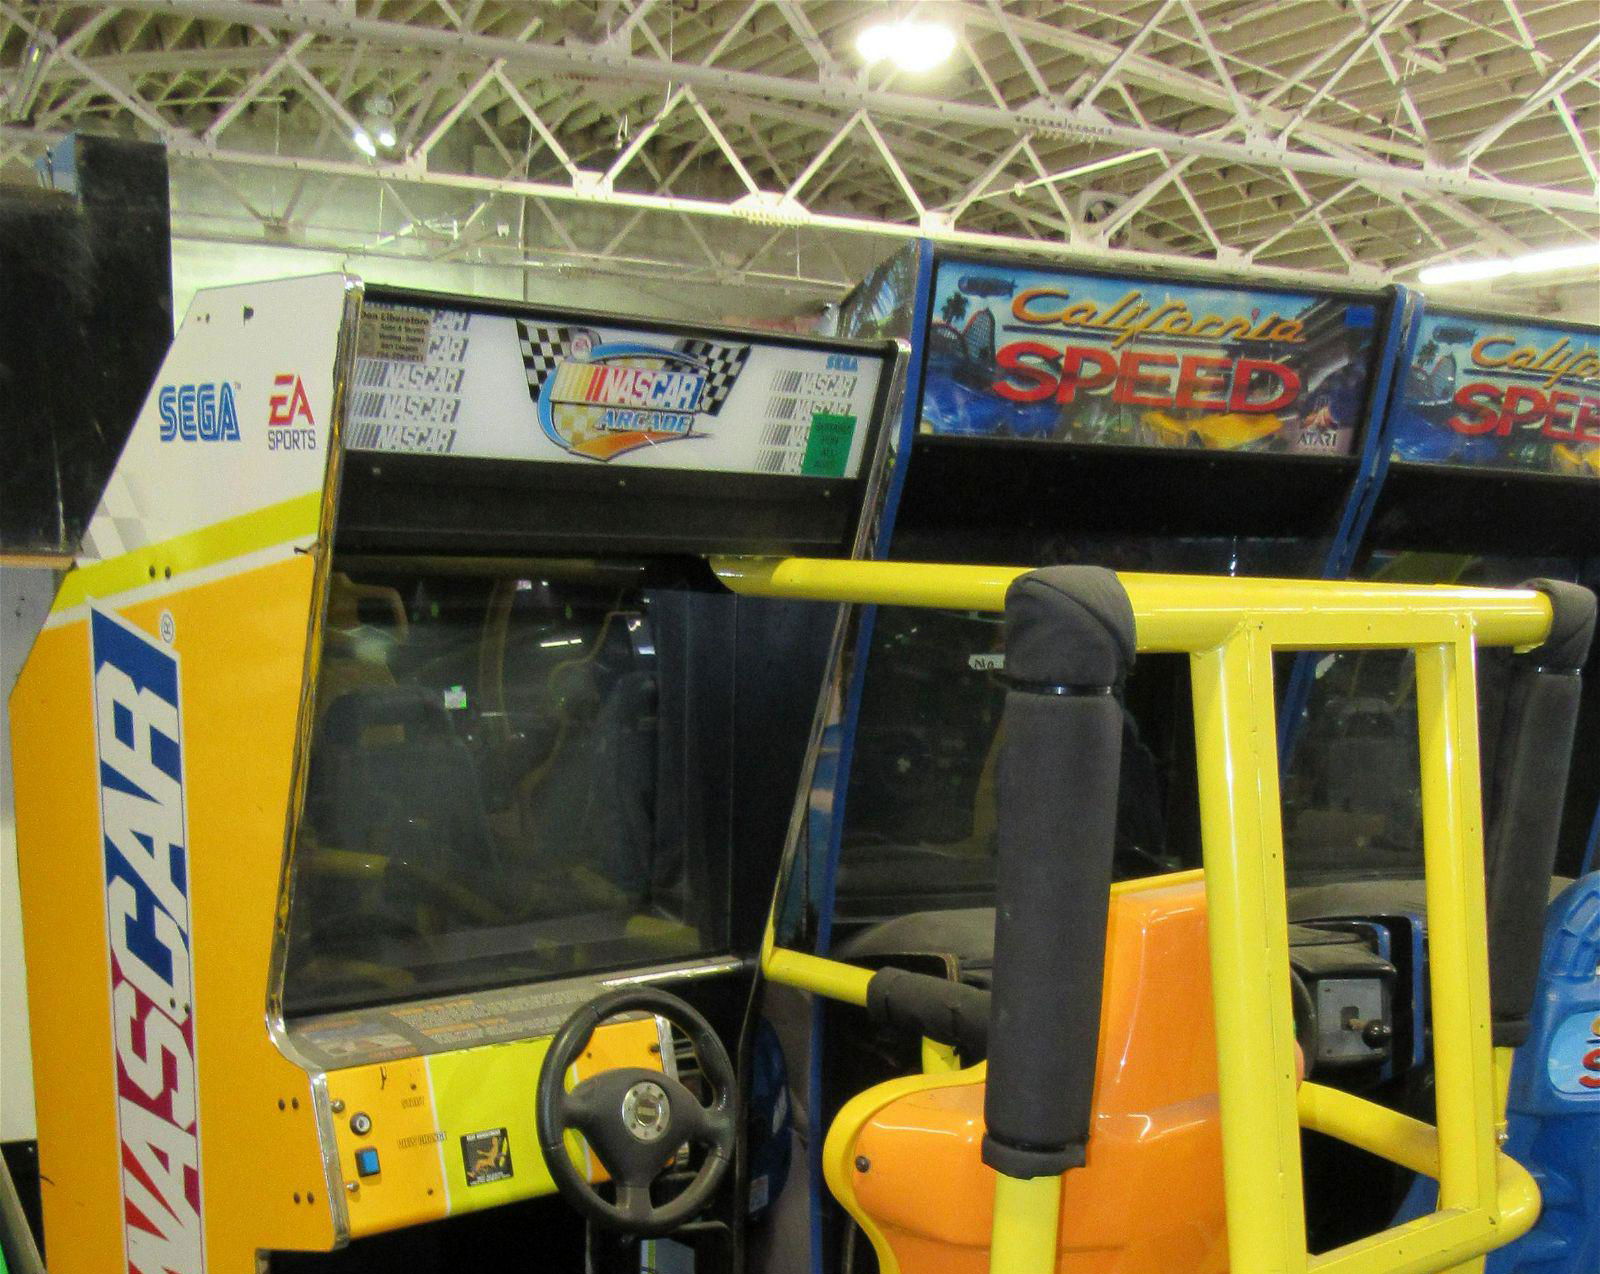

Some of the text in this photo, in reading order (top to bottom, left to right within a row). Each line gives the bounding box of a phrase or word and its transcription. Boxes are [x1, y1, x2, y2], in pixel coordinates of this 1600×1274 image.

[1011, 288, 1306, 348] California
[268, 374, 315, 426] EA
[601, 367, 706, 410] NASCAR
[993, 341, 1300, 413] SPEED
[159, 382, 240, 442] SEGA
[600, 409, 690, 433] ARCADE
[268, 429, 316, 451] SPORTS
[1297, 431, 1336, 447] ATARI
